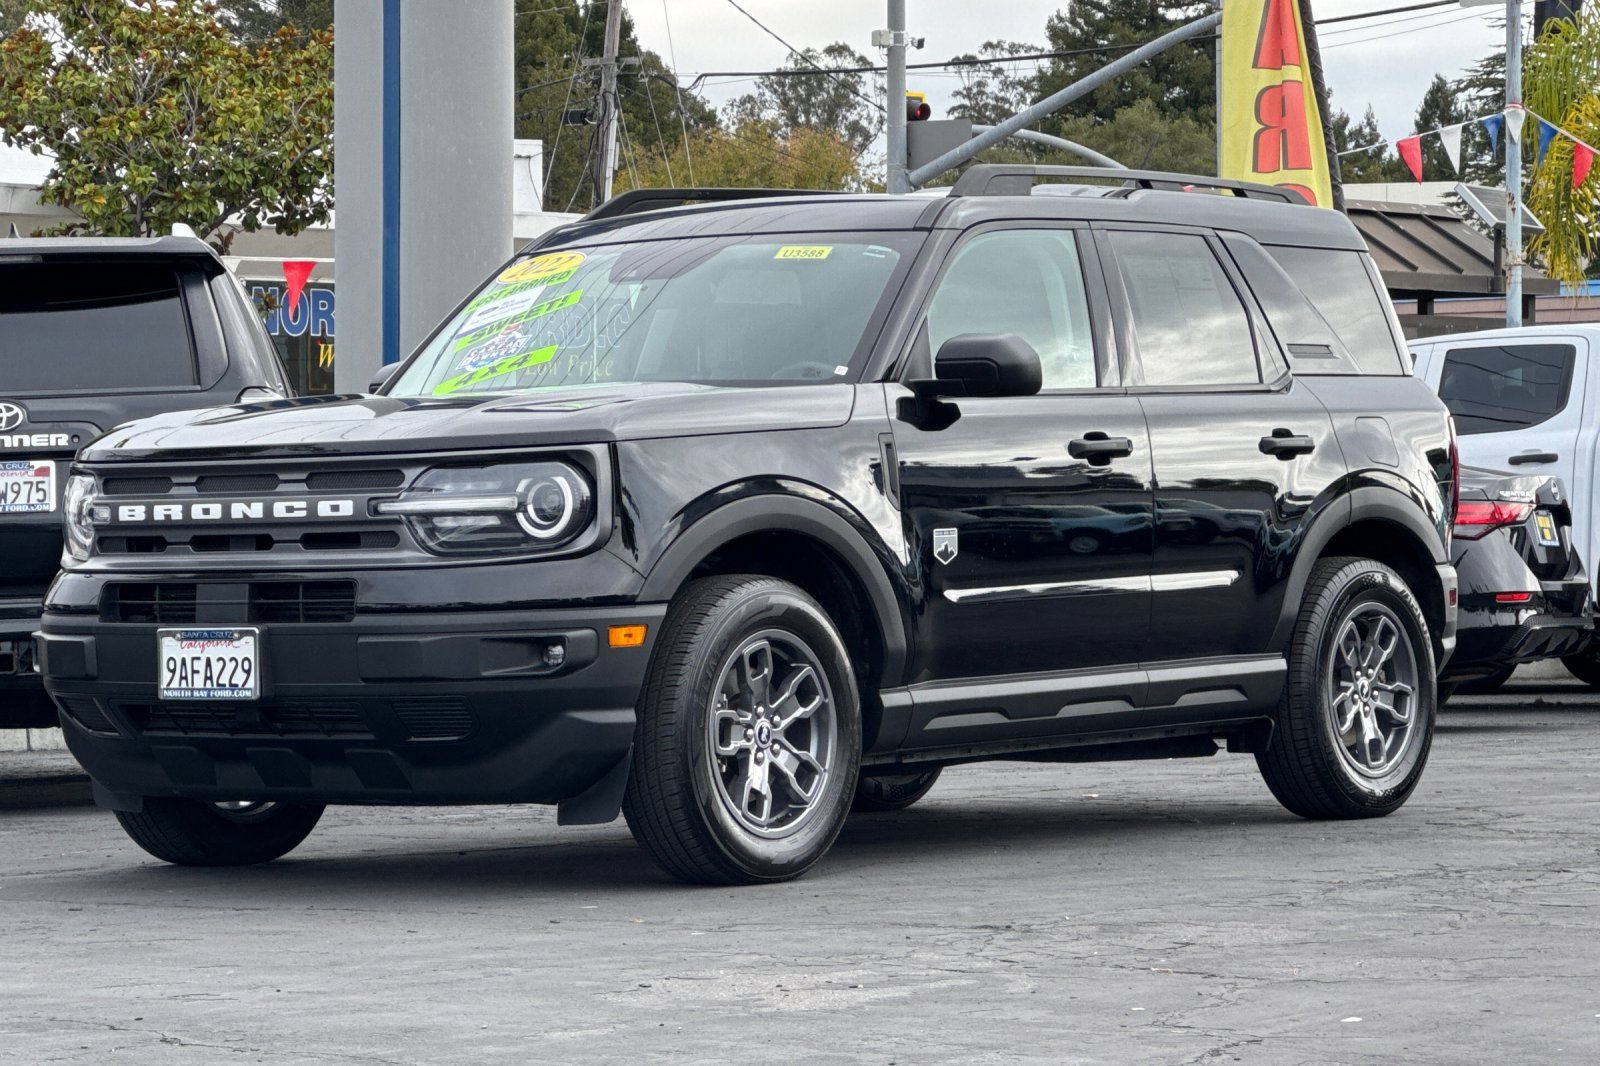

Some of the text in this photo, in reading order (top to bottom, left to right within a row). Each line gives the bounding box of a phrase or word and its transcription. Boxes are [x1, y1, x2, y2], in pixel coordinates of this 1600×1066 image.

[467, 296, 570, 344] SWEET!
[118, 500, 354, 522] BRONCO
[181, 631, 234, 639] SANTA CRUZ
[166, 656, 253, 688] 9AFA229
[163, 689, 252, 698] NORTH BAY FORD.COM
